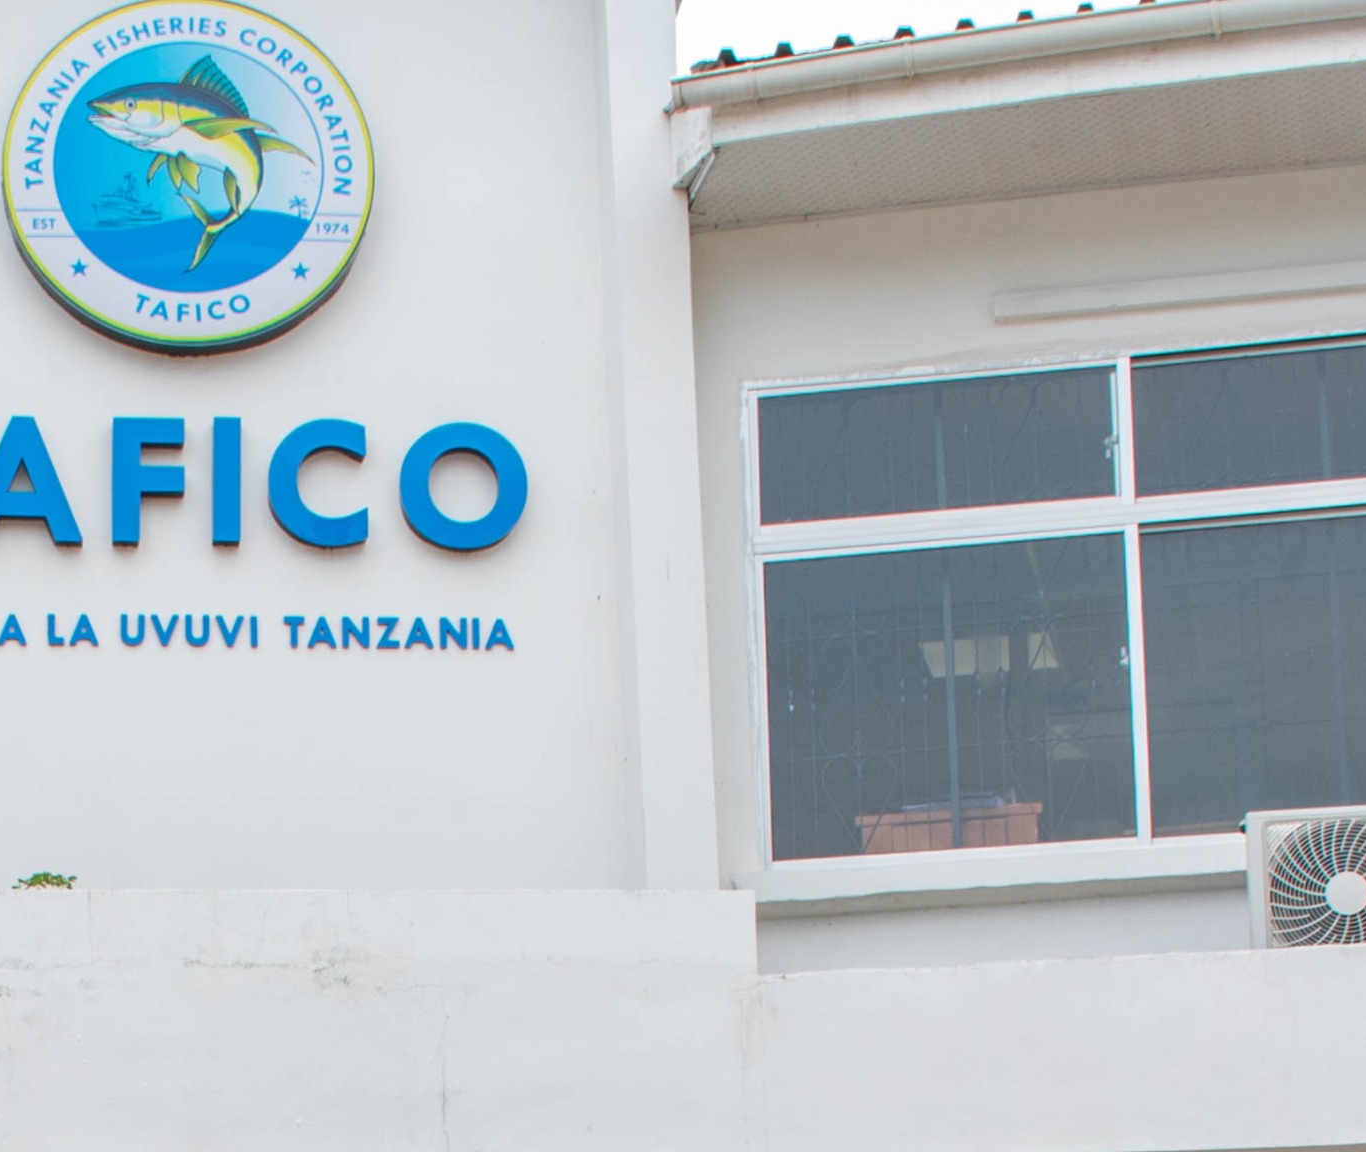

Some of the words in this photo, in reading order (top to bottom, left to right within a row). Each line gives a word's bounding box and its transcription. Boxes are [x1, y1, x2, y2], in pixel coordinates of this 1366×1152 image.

[24, 58, 90, 190] TANZANIA
[92, 16, 228, 58] FISHERIES
[239, 28, 354, 196] CORPORATION
[32, 218, 56, 231] EST
[315, 223, 350, 235] 1974
[134, 293, 251, 322] TAFICO
[47, 613, 99, 648] LA
[120, 614, 259, 649] UVUVI
[283, 615, 515, 651] TANZANIA
